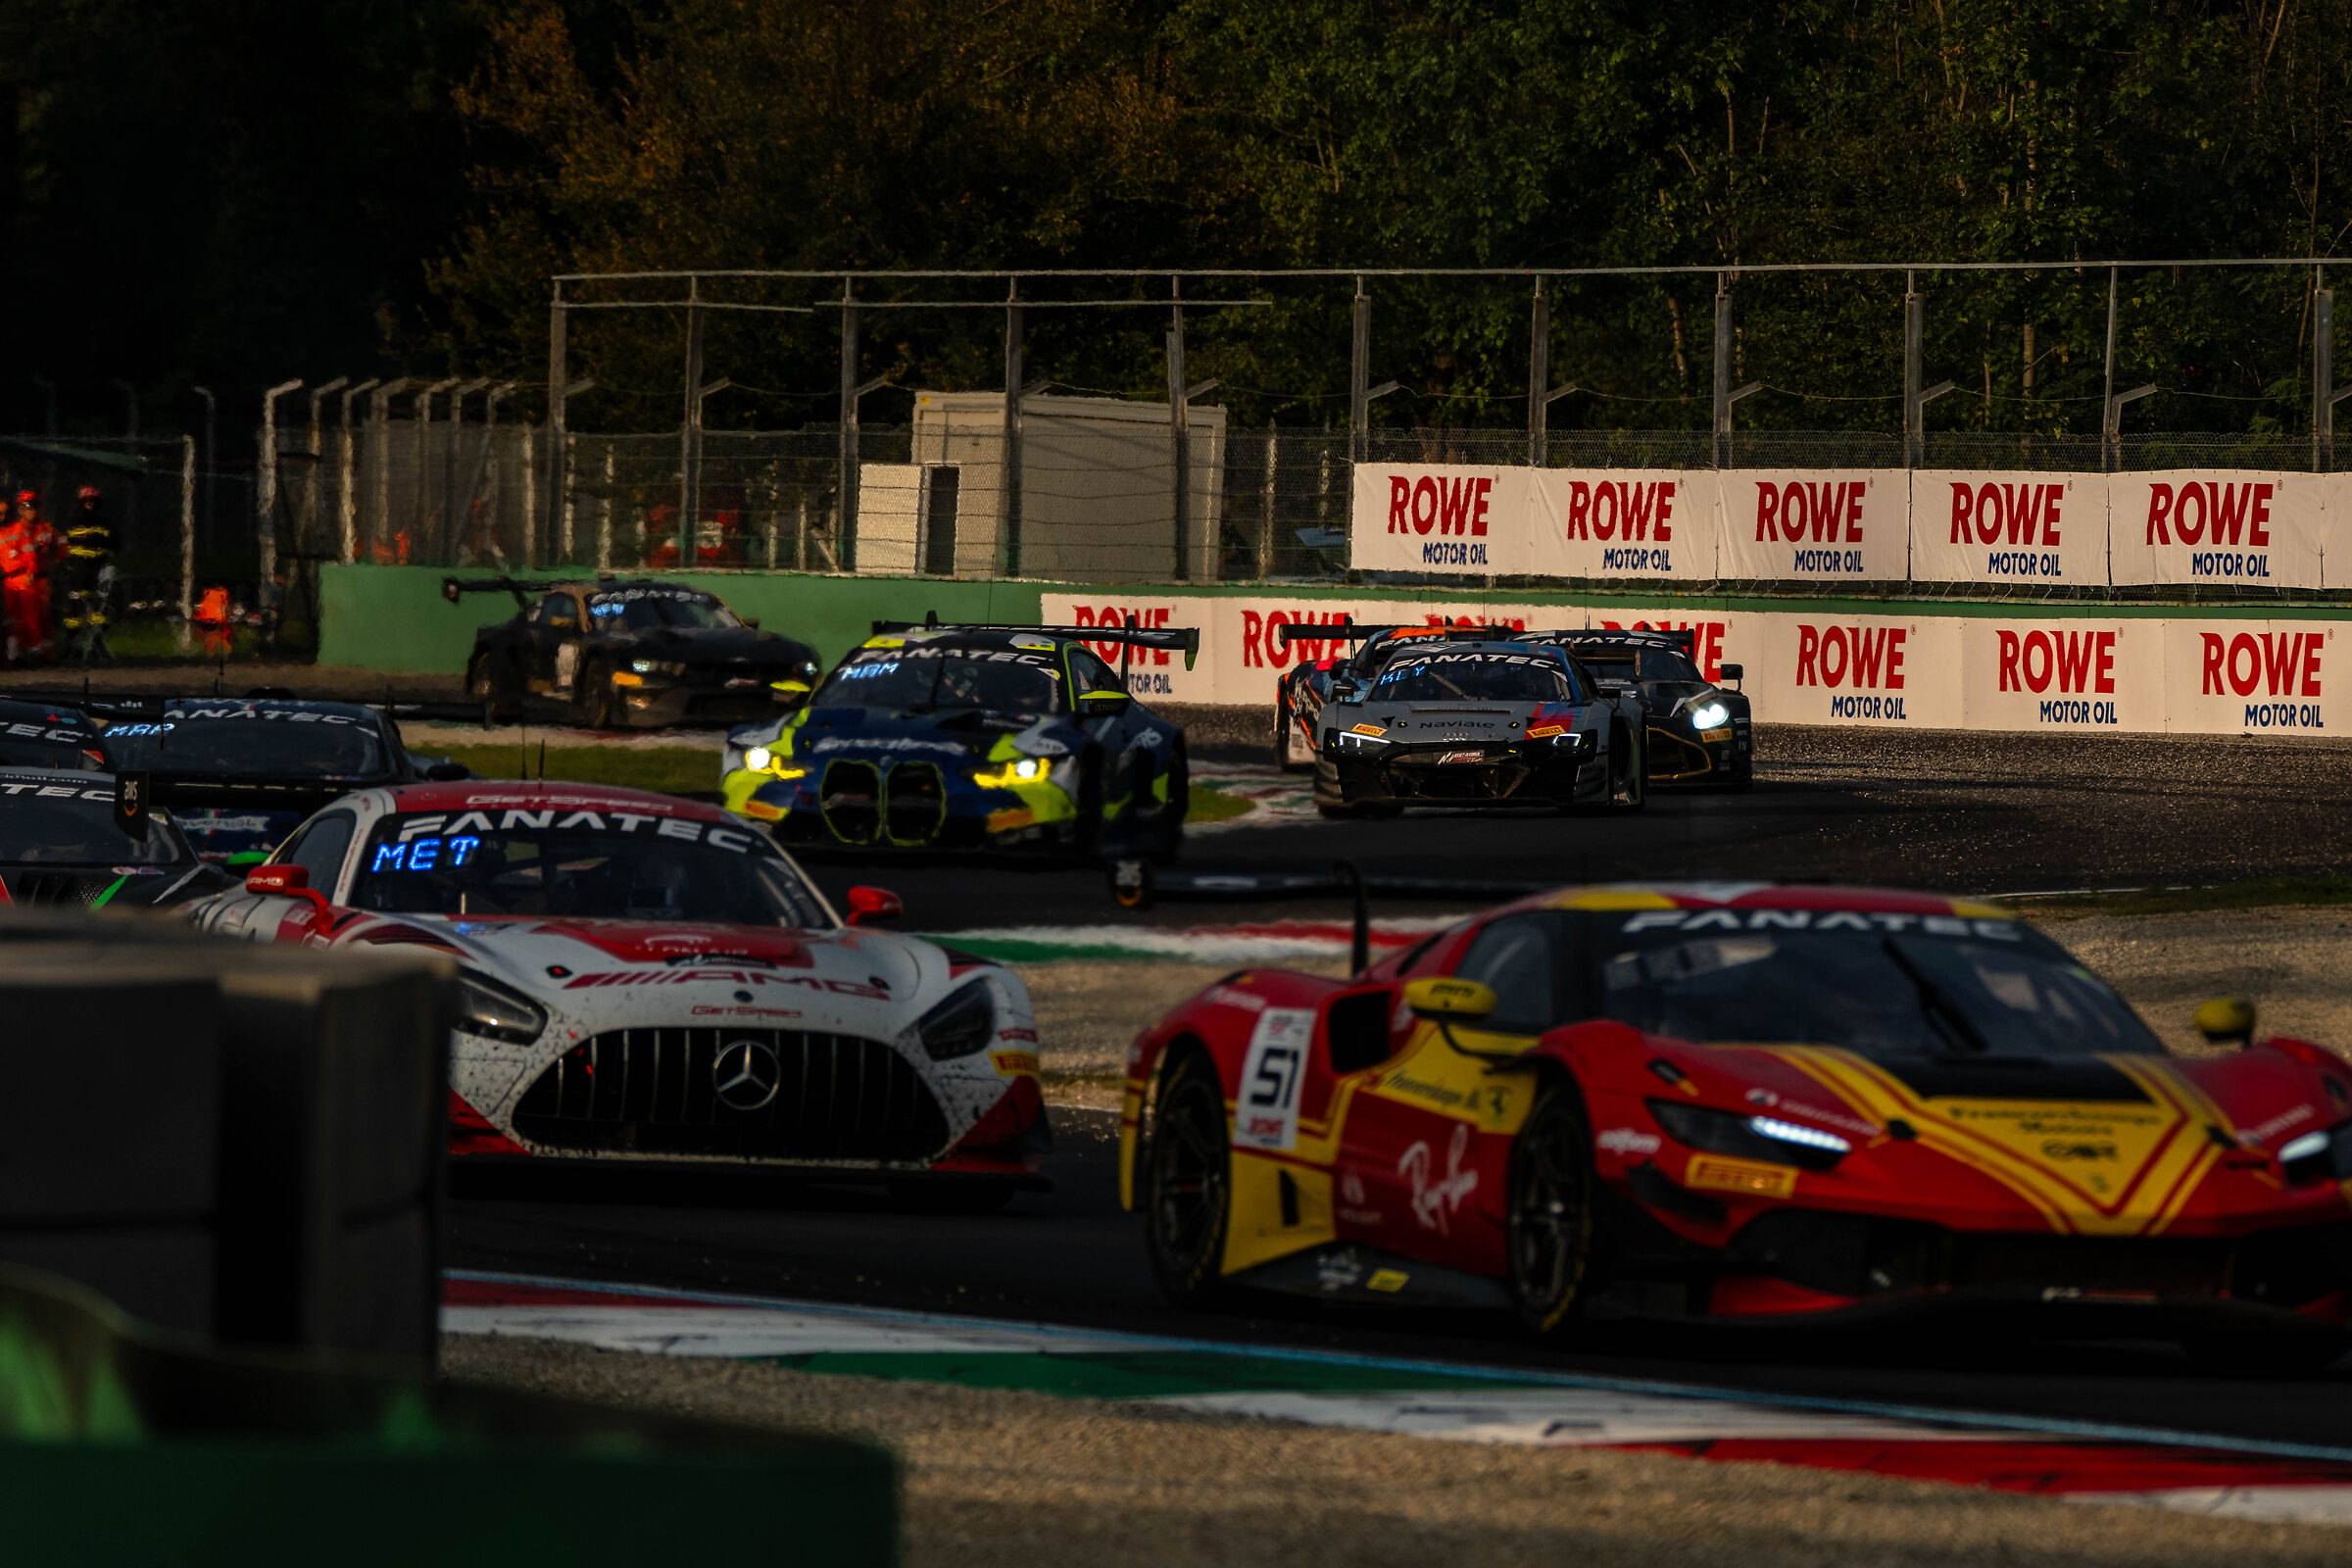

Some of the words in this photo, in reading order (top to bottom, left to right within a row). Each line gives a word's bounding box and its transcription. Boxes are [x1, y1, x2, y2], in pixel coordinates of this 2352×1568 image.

[1388, 475, 1493, 536] ROWE
[1568, 480, 1676, 542] ROWE
[1755, 481, 1866, 543] ROWE
[1949, 482, 2064, 547] ROWE
[2146, 481, 2274, 547] ROWE
[1423, 542, 1467, 565] MOTOR
[1469, 544, 1488, 565] OIL
[1603, 548, 1647, 570] MOTOR
[1651, 549, 1672, 571] OIL
[1794, 550, 1841, 572] MOTOR
[1844, 551, 1864, 572] OIL
[1988, 552, 2038, 575] MOTOR
[2040, 553, 2062, 576] OIL
[2192, 553, 2243, 576] MOTOR
[2246, 554, 2270, 577] OIL
[1241, 609, 1350, 669] ROWE
[1388, 654, 1555, 672] FANATEC
[1796, 625, 1906, 690] ROWE
[1996, 630, 2117, 694] ROWE
[2200, 632, 2325, 697] ROWE
[1153, 673, 1173, 695] OIL
[165, 709, 357, 725] ANATEC
[1832, 696, 1881, 719] MOTOR
[1884, 697, 1906, 720] OIL
[2039, 701, 2090, 723] MOTOR
[2093, 702, 2118, 724] OIL
[2245, 704, 2298, 727] MOTOR
[2300, 705, 2324, 728] OIL
[398, 808, 754, 854] FANATEC
[371, 834, 480, 874] MET
[1621, 909, 2023, 942] FANATEC
[1250, 1048, 1299, 1108] 51
